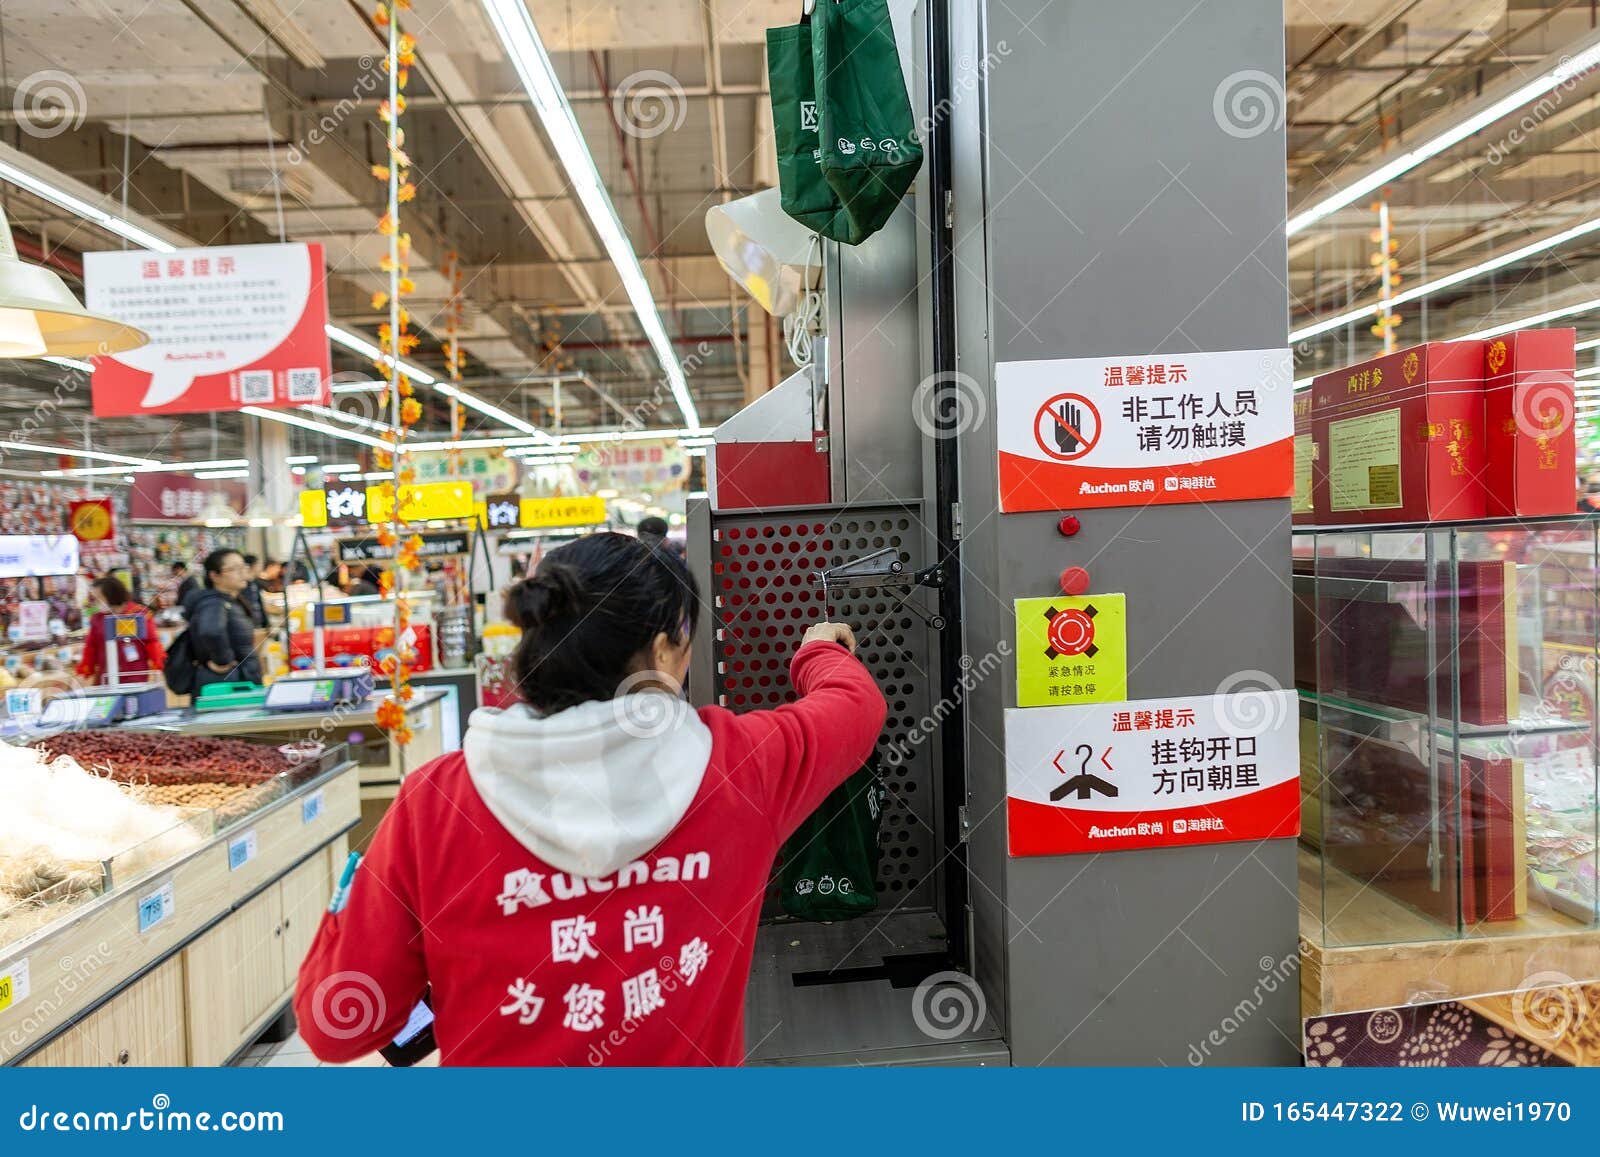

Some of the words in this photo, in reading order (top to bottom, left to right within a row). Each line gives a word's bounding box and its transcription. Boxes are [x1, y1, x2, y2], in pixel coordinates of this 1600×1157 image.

[1104, 364, 1188, 387] 温馨提示
[1347, 367, 1383, 394] 西洋参
[1122, 390, 1260, 423] 非工作人员
[1136, 420, 1247, 452] 请勿触摸
[1048, 665, 1096, 678] 紧急情况
[1048, 683, 1097, 697] 请按急停
[1112, 708, 1196, 732] 温馨提示
[1151, 736, 1257, 766] 挂钩开口
[1152, 764, 1260, 796] 方向朝里
[496, 851, 711, 916] Auchan
[550, 905, 665, 964] 欧尚
